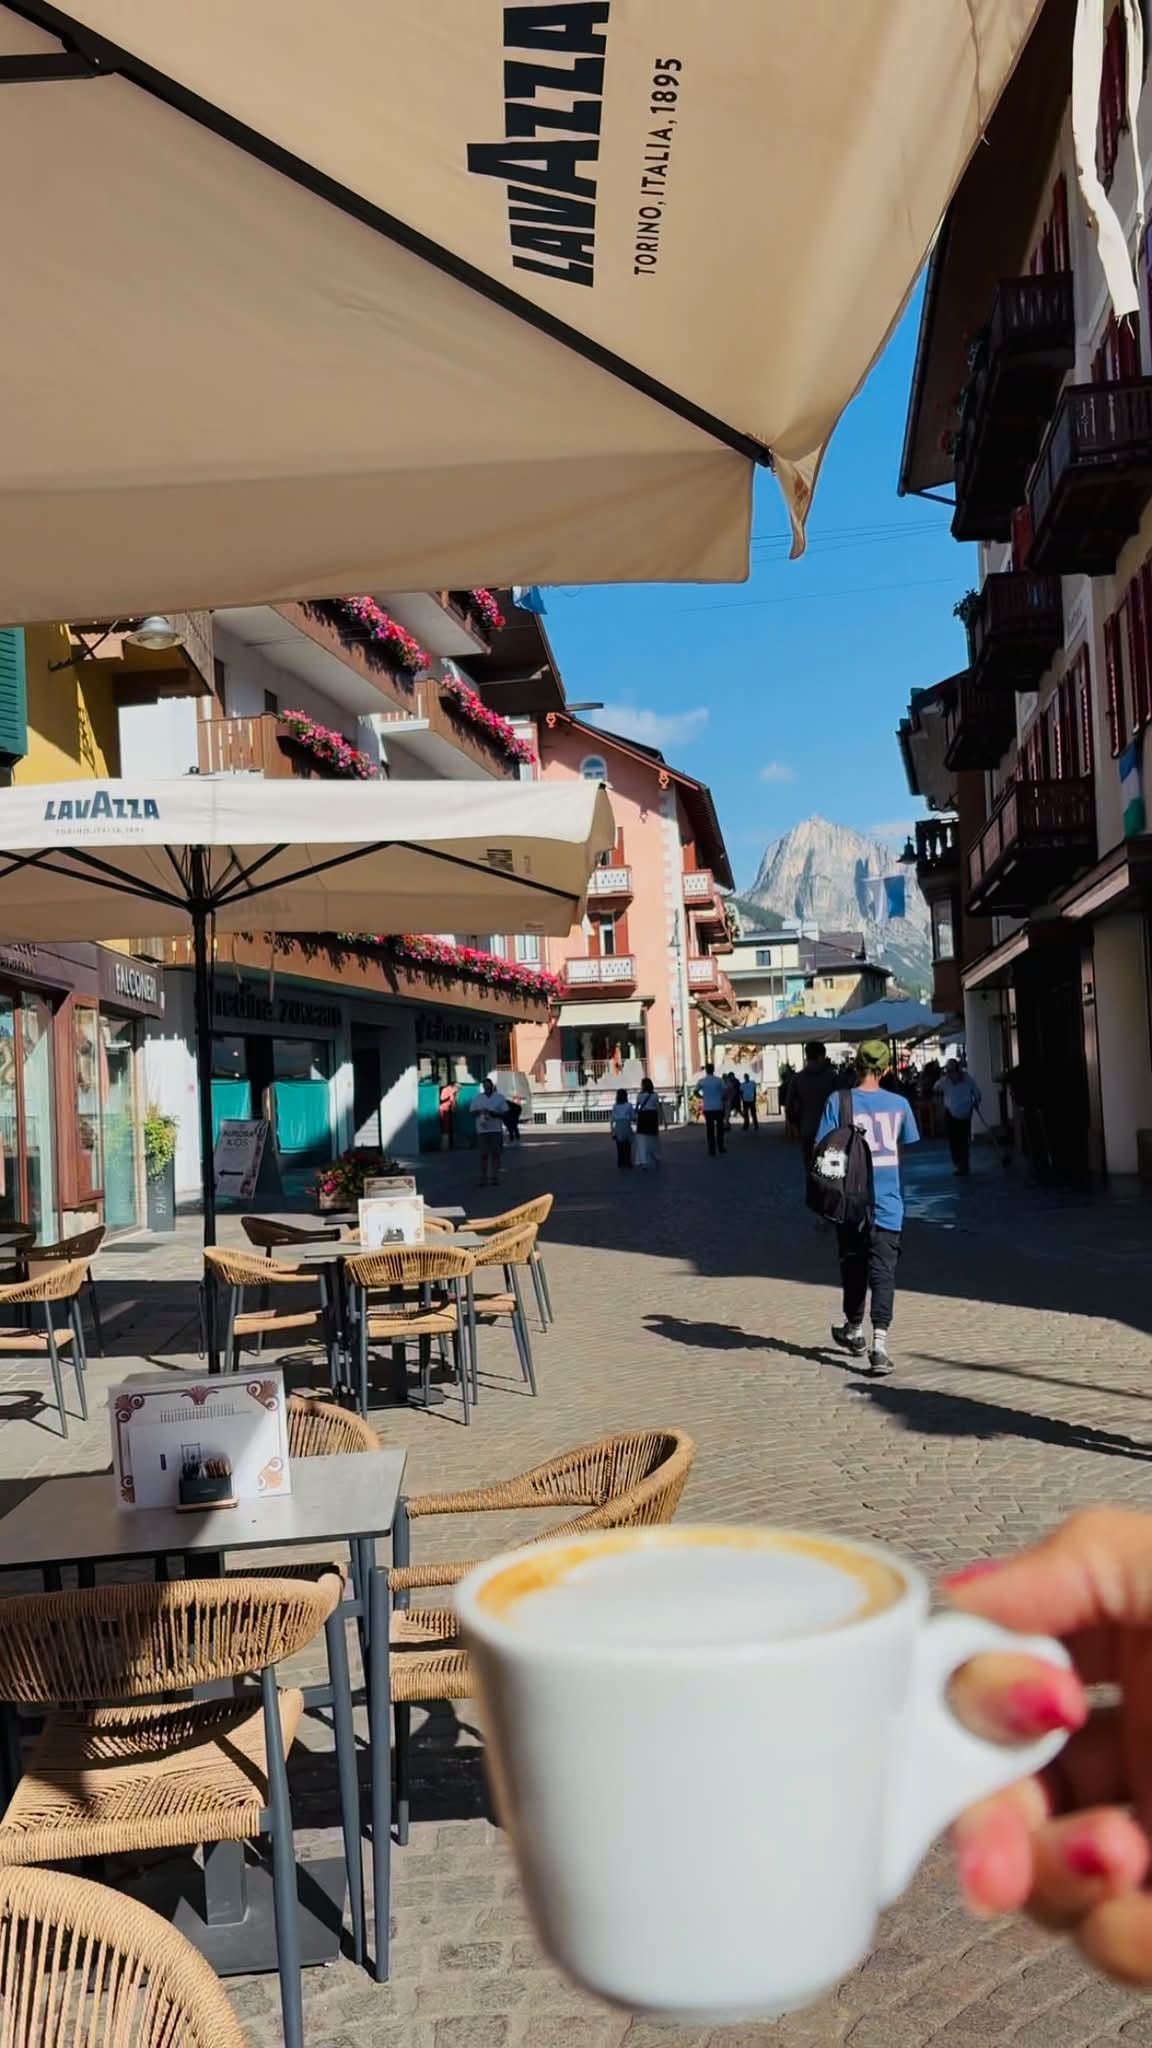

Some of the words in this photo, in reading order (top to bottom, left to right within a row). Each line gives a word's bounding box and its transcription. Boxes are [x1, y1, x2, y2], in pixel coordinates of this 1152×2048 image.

[650, 57, 683, 115] 1895
[467, 1, 610, 289] LAVAZZA
[44, 790, 161, 821] LAVAZZA
[114, 962, 157, 1003] FALCONERI
